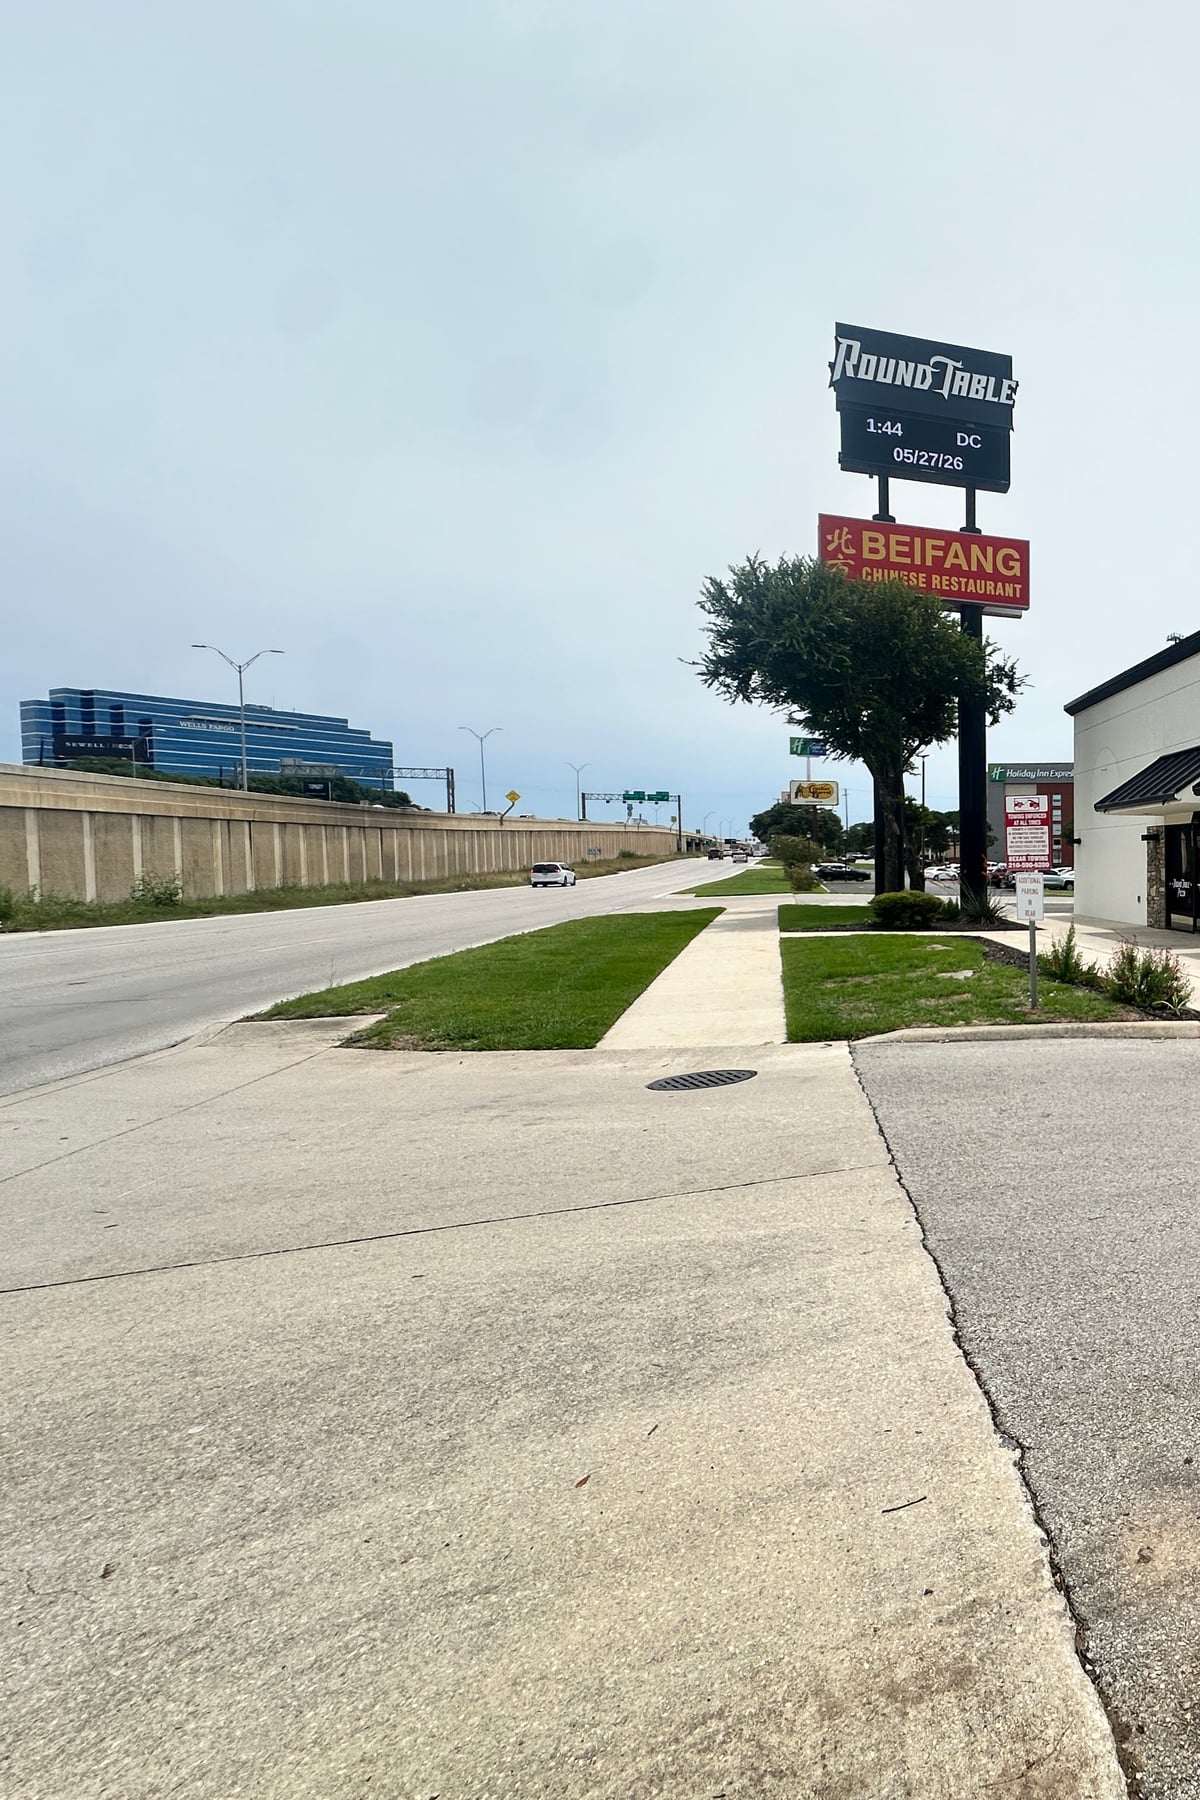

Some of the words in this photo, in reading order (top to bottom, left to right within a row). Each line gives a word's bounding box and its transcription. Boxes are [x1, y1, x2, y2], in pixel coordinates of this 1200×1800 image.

[866, 418, 903, 437] 1:44
[956, 432, 982, 449] DC
[893, 447, 964, 470] 05/27/26
[862, 530, 1020, 577] BEIFANG
[931, 574, 1022, 598] RESTAURANT
[1006, 769, 1036, 779] Holiday
[1036, 769, 1049, 777] Inn
[1050, 769, 1073, 778] Expres
